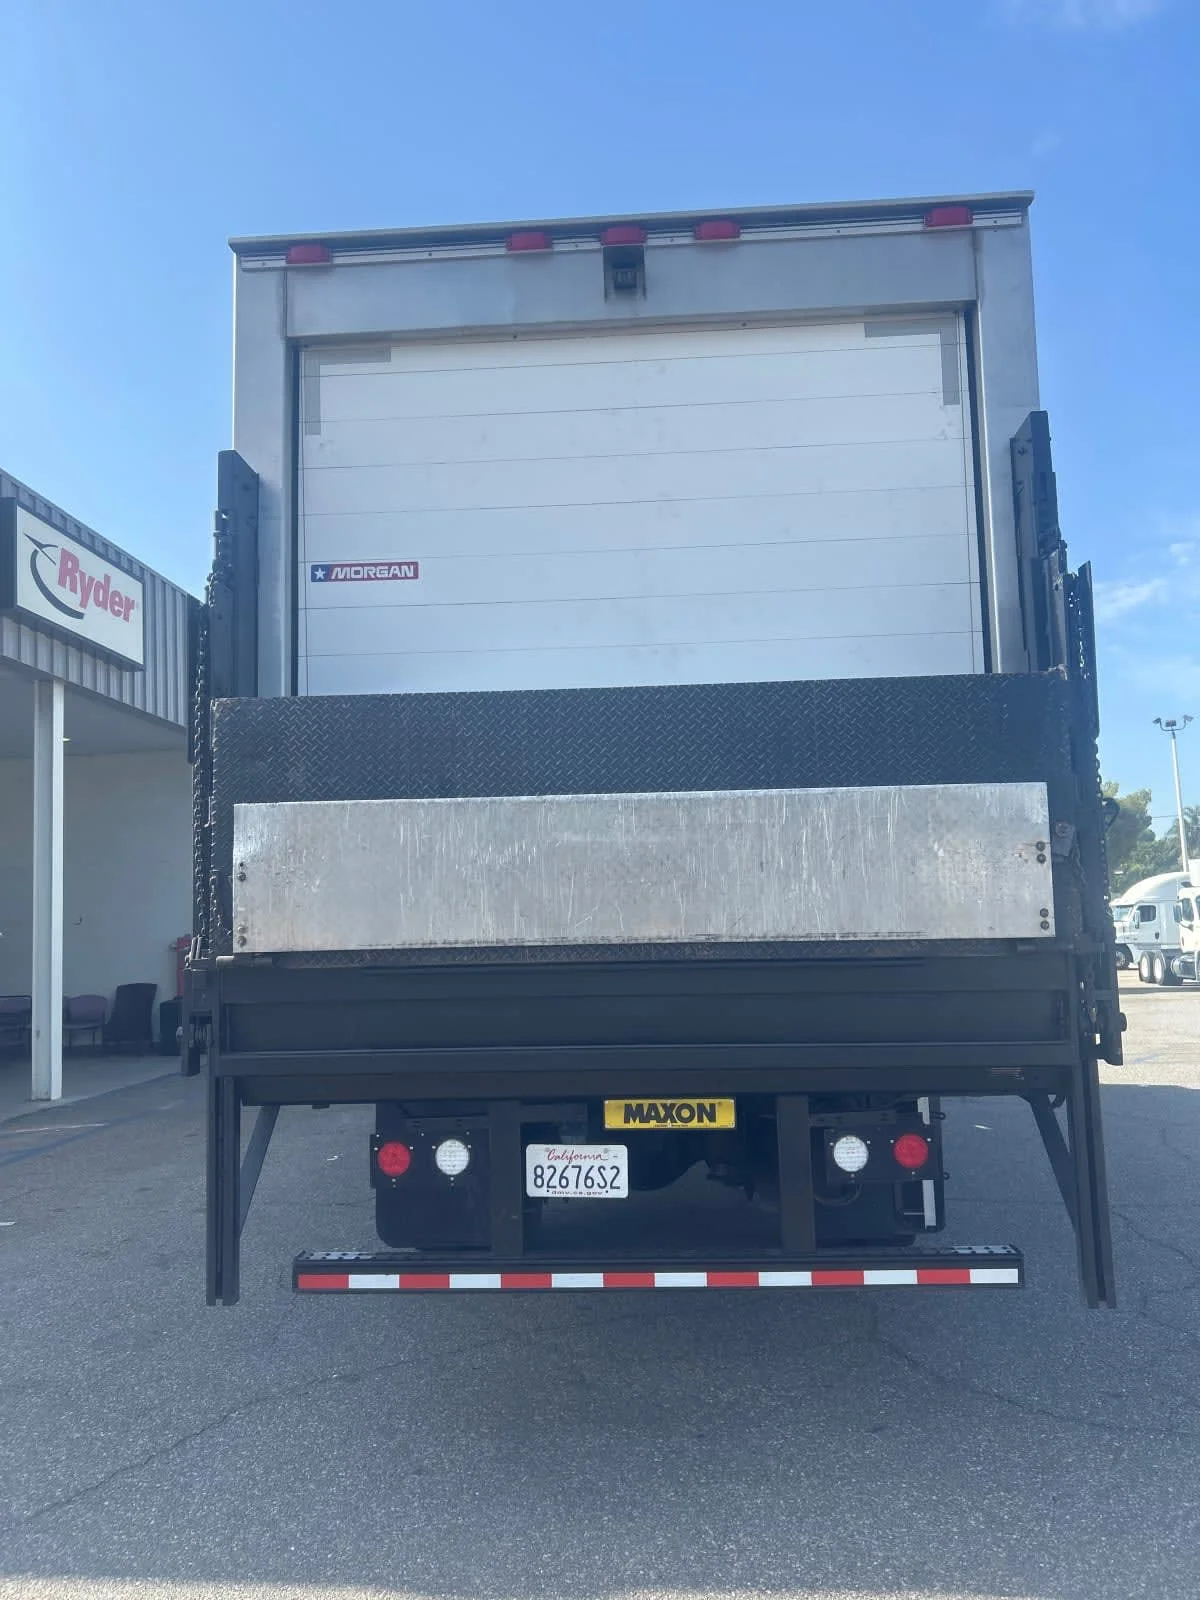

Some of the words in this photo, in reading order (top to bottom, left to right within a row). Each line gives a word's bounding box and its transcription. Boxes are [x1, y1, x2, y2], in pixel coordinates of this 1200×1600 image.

[331, 565, 414, 579] MORGAN
[58, 547, 135, 623] Ryder
[624, 1103, 717, 1123] MAXON
[547, 1149, 608, 1165] California
[533, 1165, 620, 1189] 82676S2
